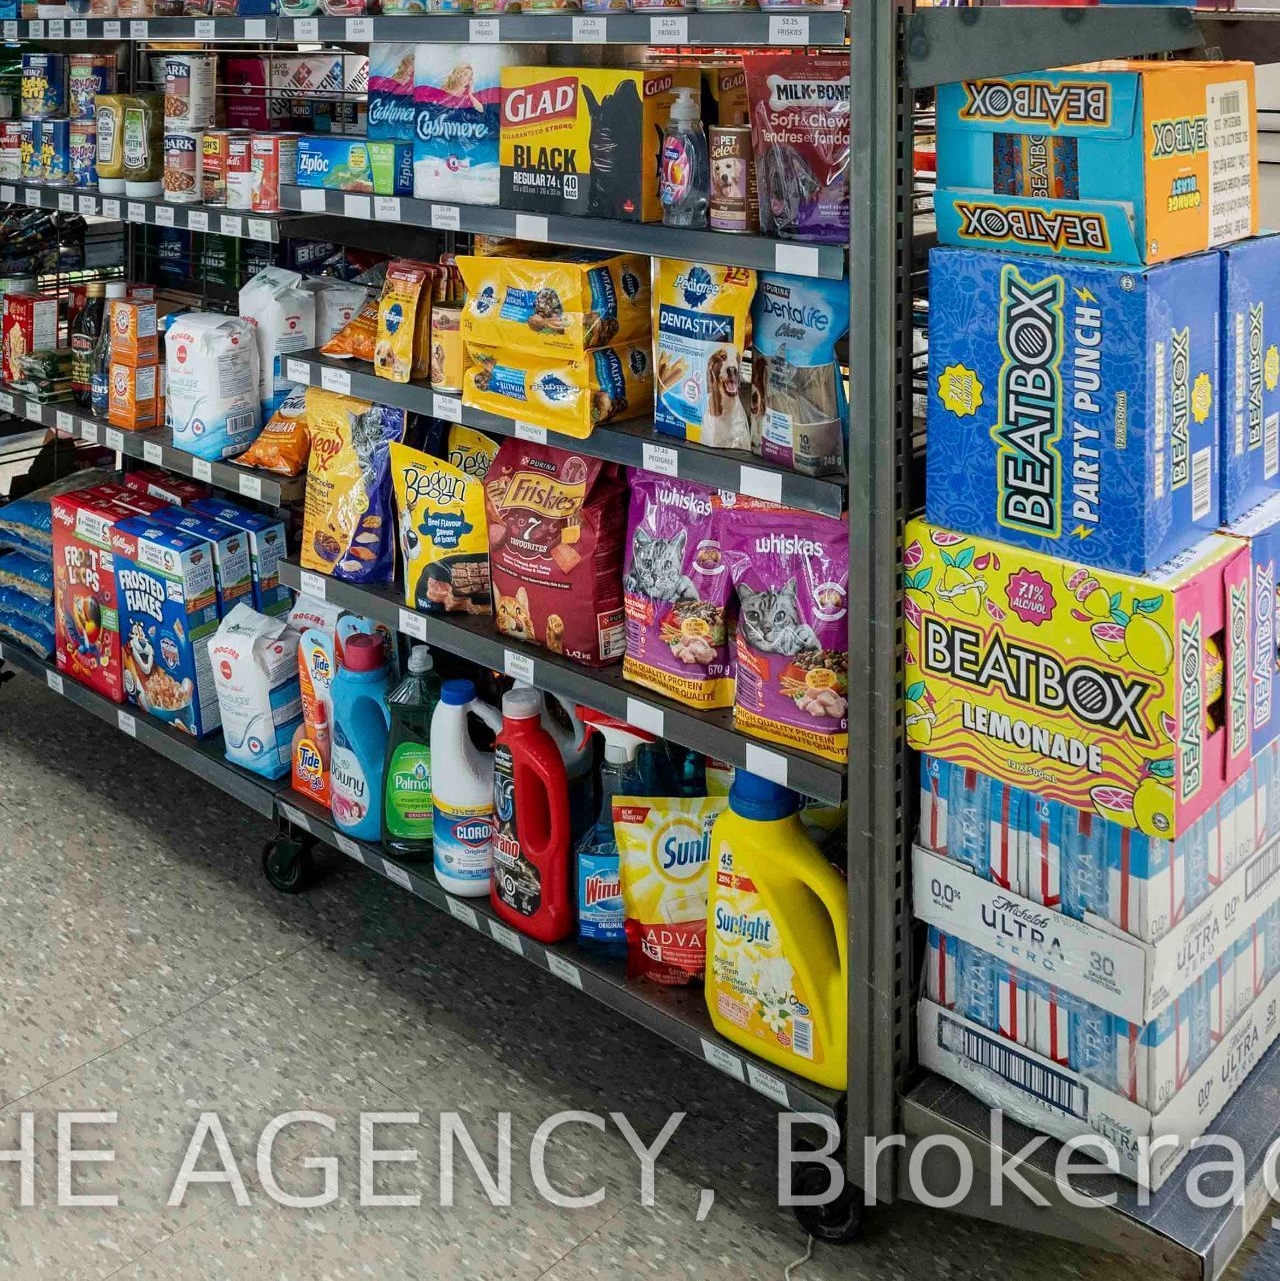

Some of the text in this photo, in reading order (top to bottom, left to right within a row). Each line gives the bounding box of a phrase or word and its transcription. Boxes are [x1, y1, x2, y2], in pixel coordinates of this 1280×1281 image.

[658, 28, 681, 36] FRISKIES
[777, 28, 802, 36] FRISKIES
[645, 78, 671, 96] GLAD
[721, 75, 745, 92] GLAD
[776, 83, 811, 101] MILK
[504, 84, 576, 123] GLAD
[968, 83, 1107, 122] BEATBOX
[417, 110, 489, 140] Cashmere
[771, 113, 799, 128] Soft
[720, 135, 736, 145] PET
[762, 128, 850, 146] Tendres et fonda
[513, 144, 577, 173] BLACK
[711, 143, 741, 158] Select
[299, 153, 329, 174] Ziploc
[399, 149, 413, 187] Ziploc
[513, 171, 545, 187] REGULAR
[546, 174, 556, 187] 74
[564, 176, 577, 190] 40
[961, 205, 1105, 249] BEATBOX
[673, 274, 719, 296] Pedigree
[766, 284, 789, 298] PURINA
[660, 310, 726, 336] DENTASTIX
[606, 348, 621, 394] VITALITY+
[1249, 307, 1261, 446] BEATBOX
[1005, 278, 1059, 531] BEATBOX
[1072, 305, 1103, 523] PARTY PUNCH
[1172, 335, 1188, 486] BEATBOX
[799, 434, 809, 444] 10
[529, 459, 557, 472] PURINA
[648, 454, 674, 466] PEDIGREE
[516, 478, 575, 511] Friskies
[659, 487, 712, 516] whiskas
[427, 517, 462, 527] Beef Flavour
[522, 517, 541, 540] 7
[112, 534, 136, 555] Kellogg's
[755, 533, 824, 557] whiskas
[118, 569, 165, 602] FROSTED
[1018, 580, 1045, 601] 7.1%
[125, 590, 163, 622] FLAKES
[292, 613, 325, 626] ROGERS
[212, 645, 240, 660] ROGERS
[1255, 567, 1273, 728] BEATBOX
[312, 653, 330, 672] Tide
[708, 664, 723, 676] 670
[1233, 587, 1247, 755] BEATBOX
[667, 674, 703, 691] PROTEIN
[924, 624, 1151, 739] BEATBOX
[1182, 622, 1200, 798] BEATBOX
[737, 709, 835, 745] HIGH QUALITY PROTEIN
[962, 702, 1104, 774] LEMONADE
[298, 745, 320, 769] Tide
[330, 759, 365, 797] Downy
[395, 774, 432, 791] Palmol
[663, 830, 712, 869] Sunli
[720, 853, 733, 866] 45
[585, 875, 622, 906] Wind
[992, 895, 1049, 929] Michelob
[646, 928, 701, 945] ADVA
[715, 907, 771, 943] Sunlight
[981, 904, 1067, 961] ULTRA
[995, 935, 1057, 973] ZERO
[1176, 919, 1220, 970] ULTRA
[714, 955, 735, 967] Original
[723, 965, 739, 976] Fresh
[1089, 950, 1115, 976] 30
[1221, 1024, 1259, 1085] ULTRA
